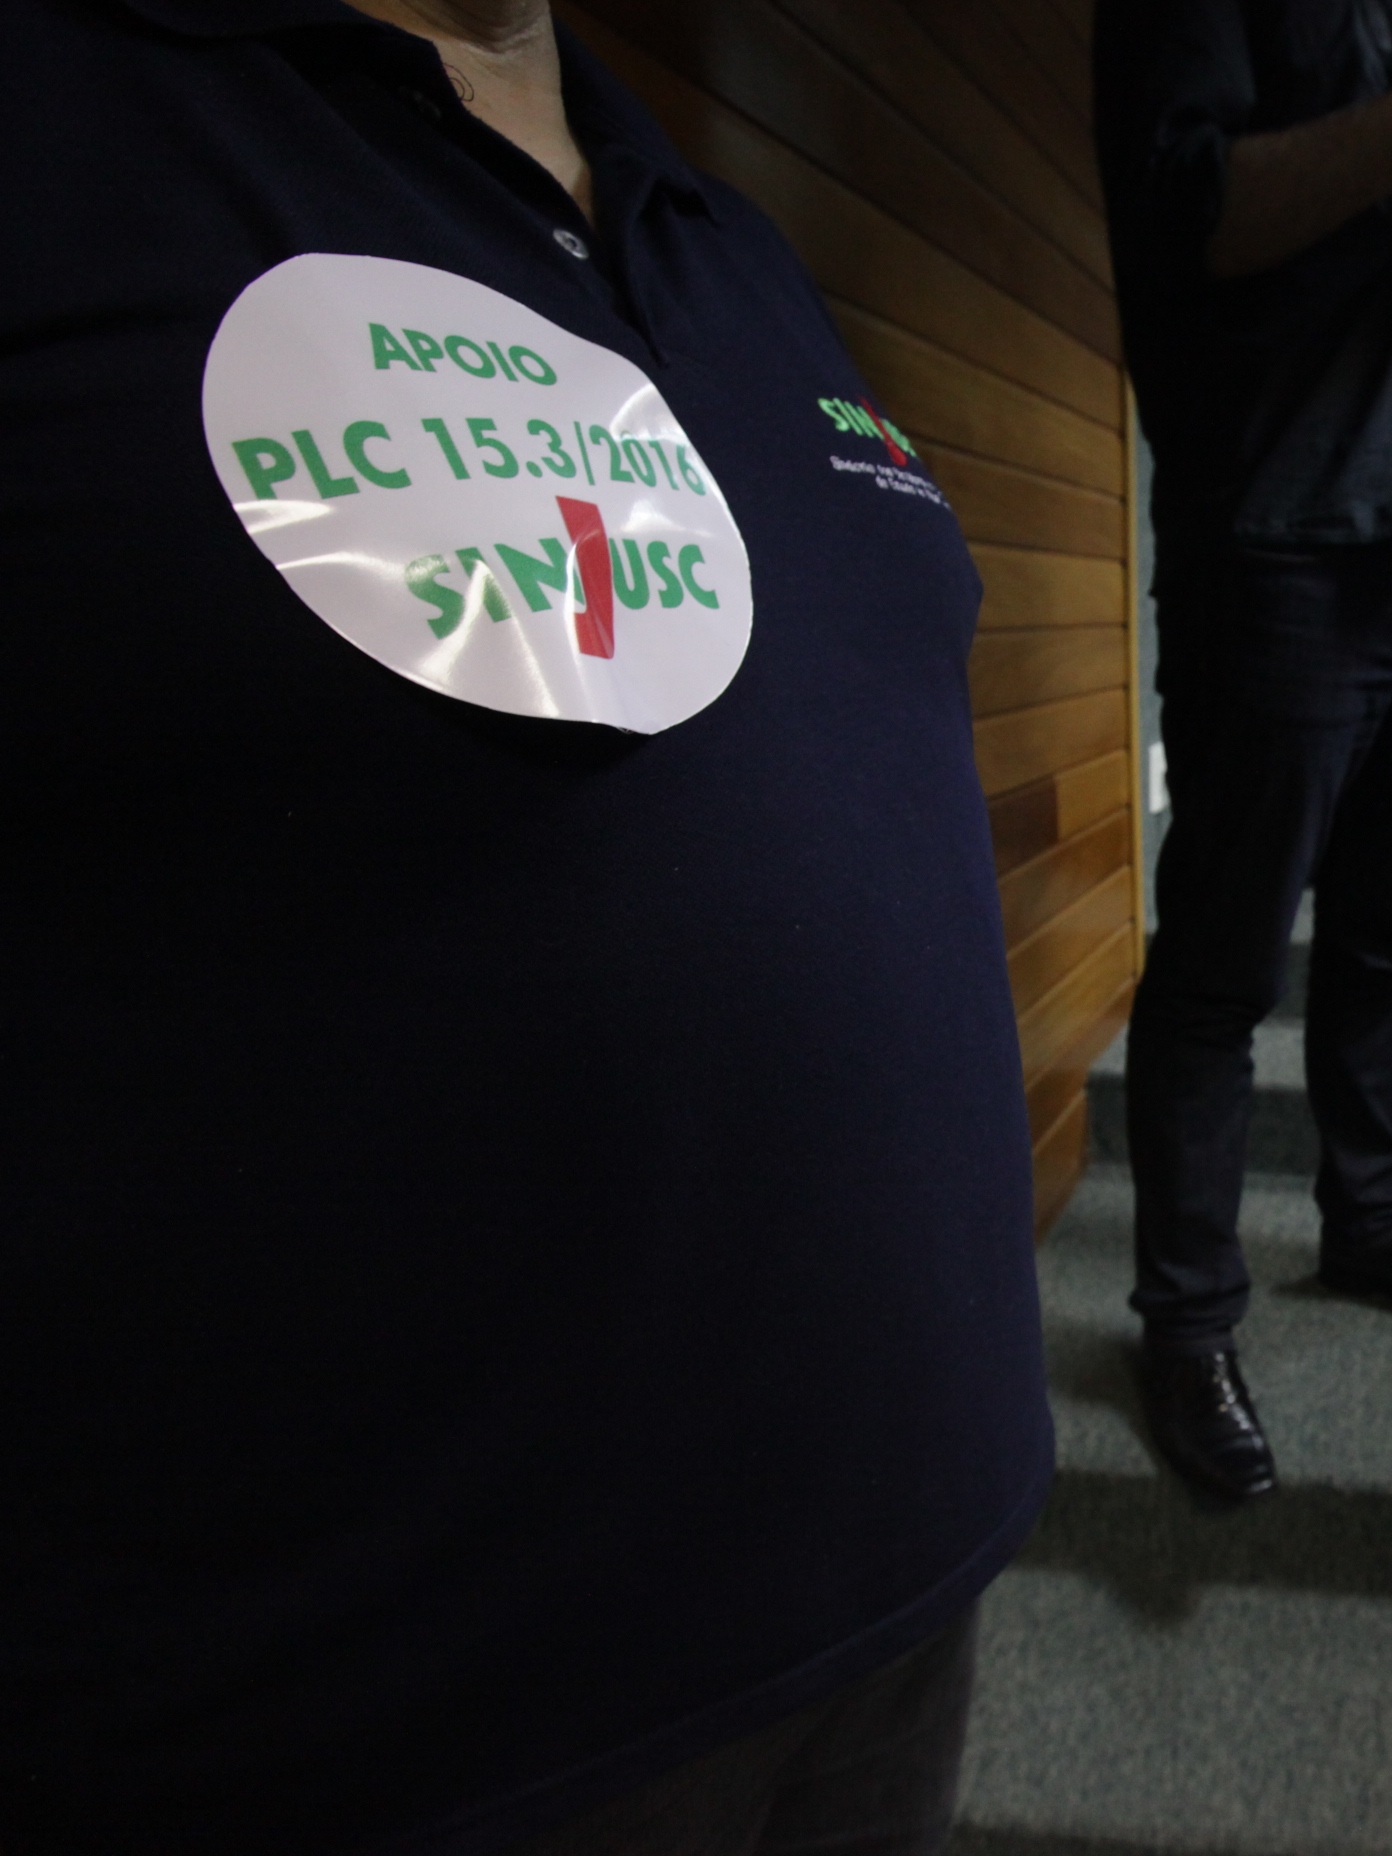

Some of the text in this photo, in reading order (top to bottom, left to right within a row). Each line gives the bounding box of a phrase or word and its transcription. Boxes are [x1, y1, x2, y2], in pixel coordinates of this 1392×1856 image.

[368, 322, 557, 386] APOIO
[231, 417, 707, 500] PLC 15.3/2016
[404, 495, 720, 660] SINJUSC
